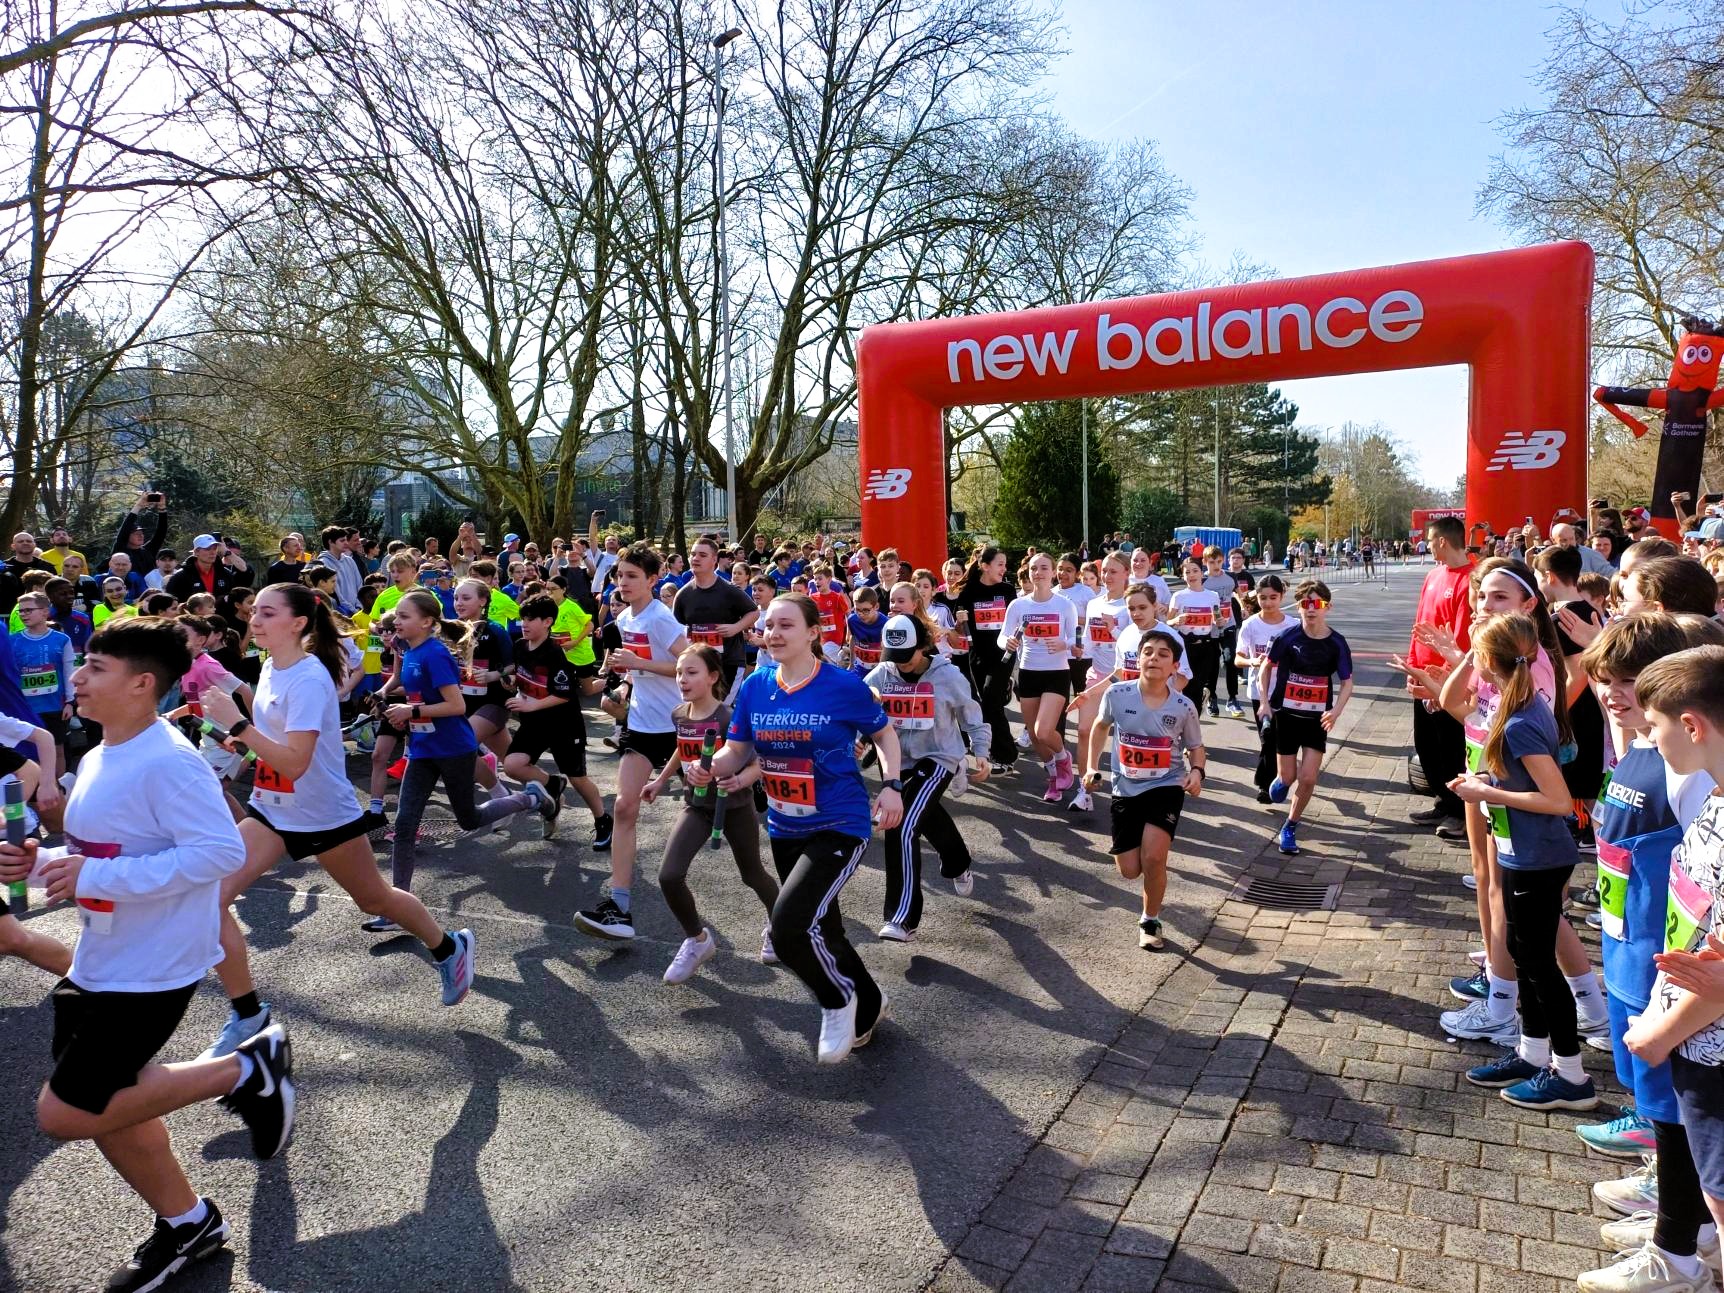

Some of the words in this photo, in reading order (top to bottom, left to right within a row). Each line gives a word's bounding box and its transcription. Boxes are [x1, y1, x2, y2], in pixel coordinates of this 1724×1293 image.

[947, 329, 1079, 383] new
[1097, 290, 1425, 371] balance
[1485, 430, 1567, 471] NB
[864, 468, 913, 501] NB
[979, 611, 1001, 621] 39-1
[1029, 625, 1053, 636] 16-1
[24, 674, 56, 688] 100-2
[894, 684, 913, 694] Bayer
[1289, 686, 1324, 701] 149-1
[751, 711, 832, 726] LEVERKUSEN
[755, 730, 812, 741] FINISHER
[1130, 736, 1150, 746] Bayer
[771, 741, 796, 749] 2024
[1124, 749, 1160, 766] 20-1
[766, 759, 788, 771] Bayer
